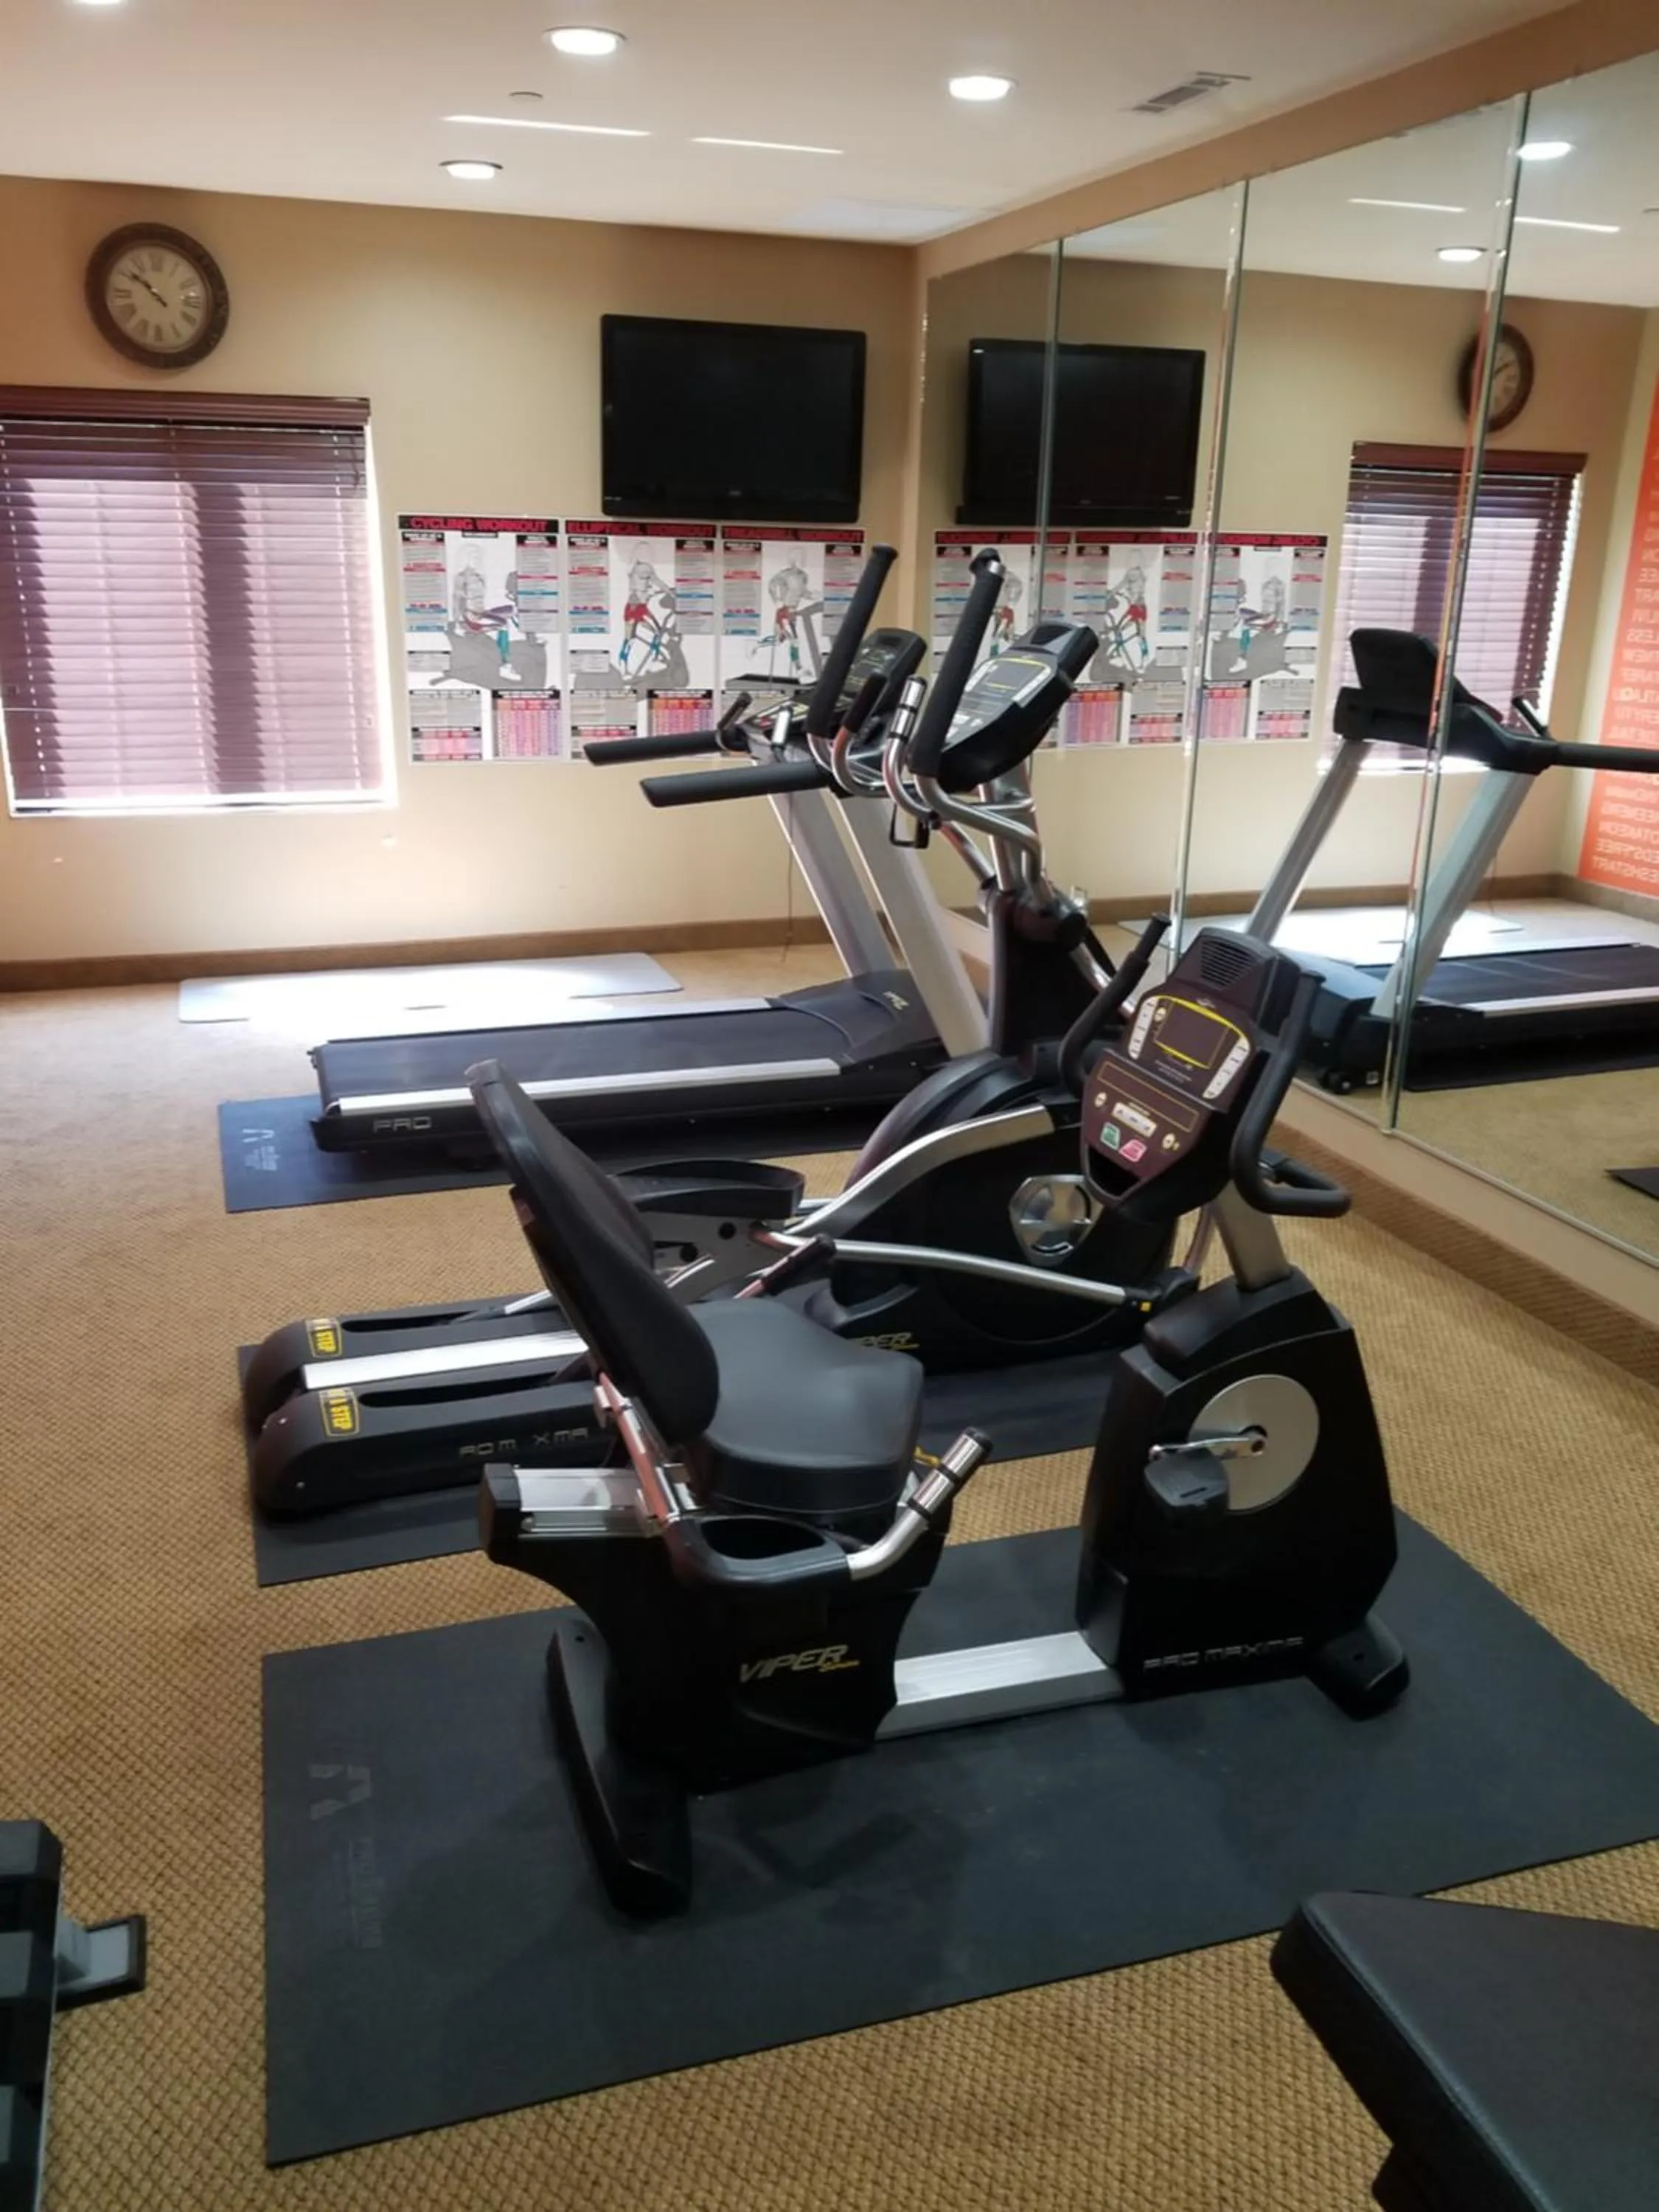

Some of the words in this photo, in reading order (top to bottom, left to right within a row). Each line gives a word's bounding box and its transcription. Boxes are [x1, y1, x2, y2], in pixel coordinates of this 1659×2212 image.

[411, 517, 473, 529] CYCLING
[476, 519, 548, 532] WORKOUT
[372, 1116, 431, 1133] PRO
[740, 1644, 849, 1683] VIPER
